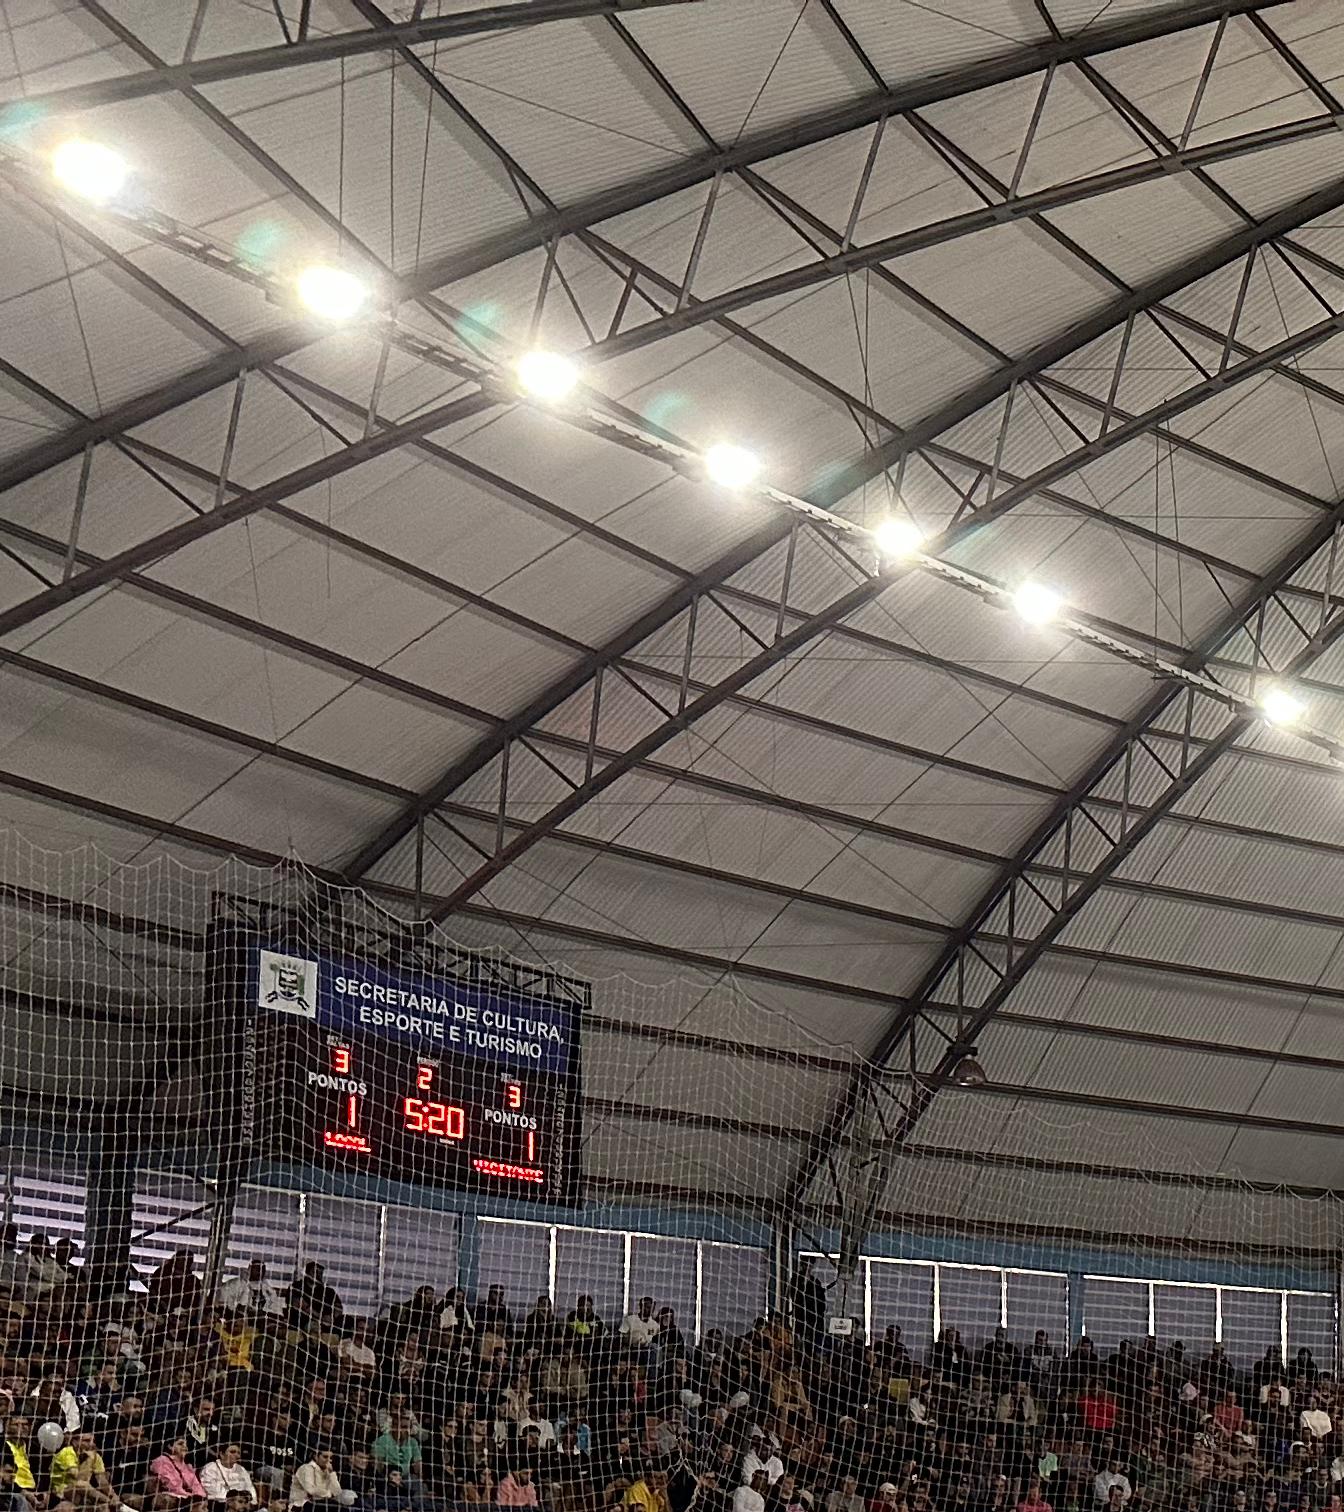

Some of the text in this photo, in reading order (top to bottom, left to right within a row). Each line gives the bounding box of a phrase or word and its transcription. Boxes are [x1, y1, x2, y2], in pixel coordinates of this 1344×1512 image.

[335, 976, 565, 1044] SECRETARIA DE CULTURA,
[359, 1006, 543, 1059] ESPORTE E TURISMO
[335, 1049, 350, 1074] 3
[308, 1071, 368, 1096] PONTOS
[417, 1067, 433, 1090] 2
[508, 1085, 521, 1108] 3
[404, 1098, 465, 1140] 5:20
[484, 1108, 538, 1130] PONTOS
